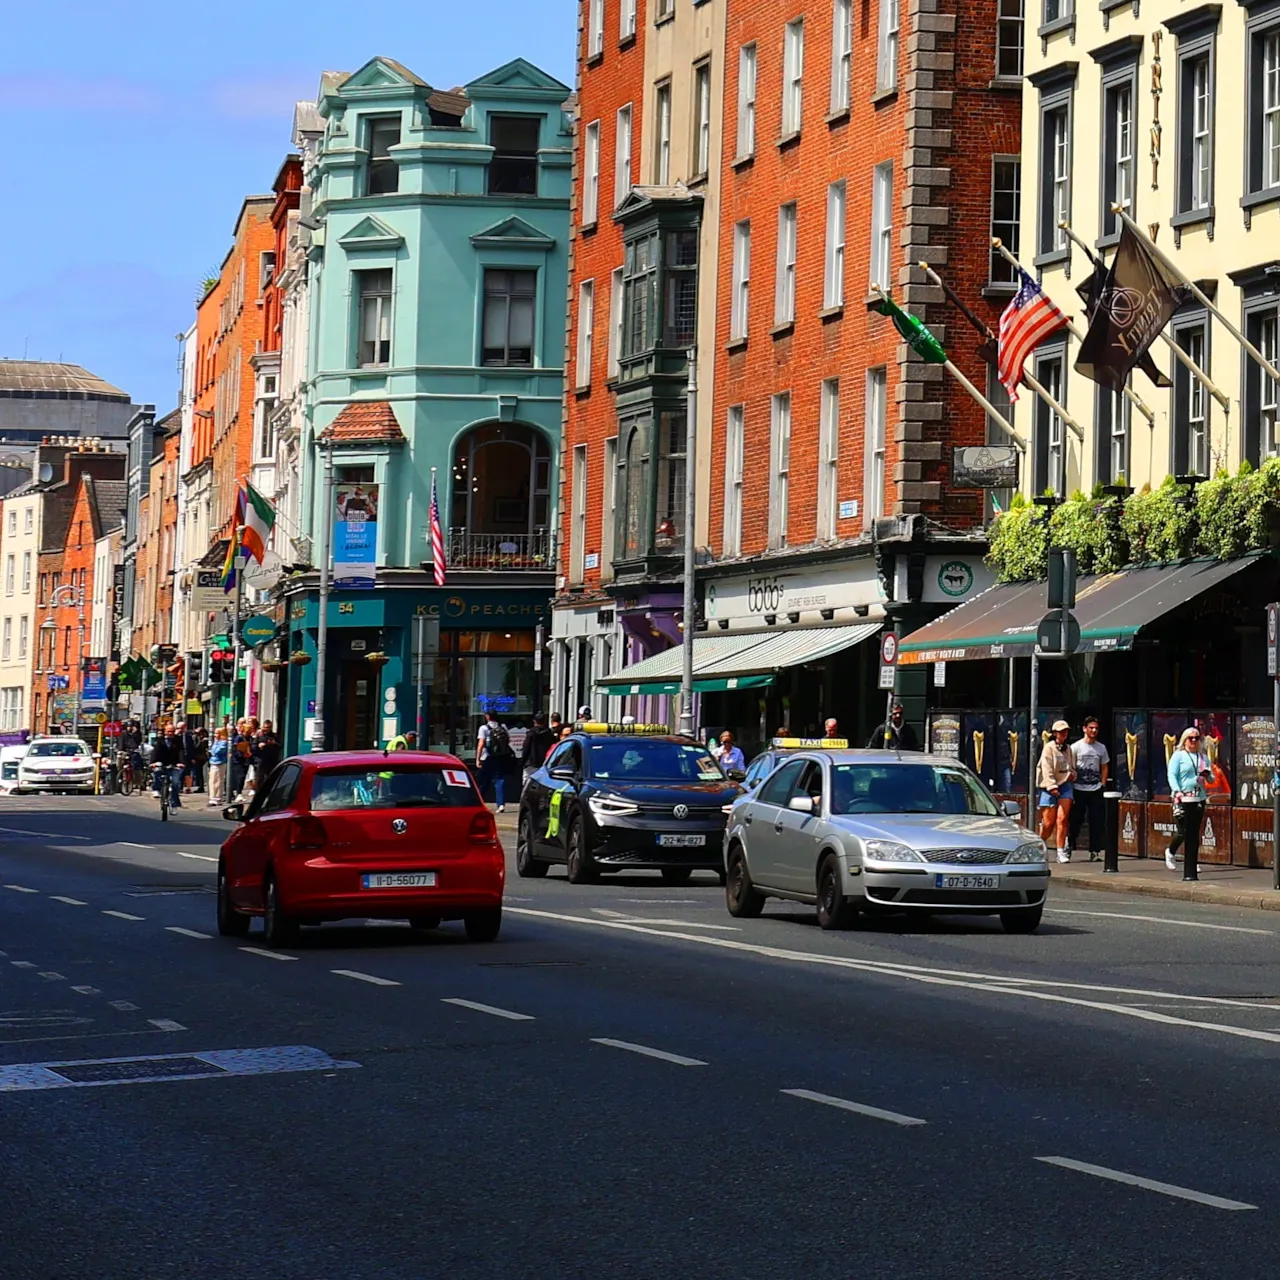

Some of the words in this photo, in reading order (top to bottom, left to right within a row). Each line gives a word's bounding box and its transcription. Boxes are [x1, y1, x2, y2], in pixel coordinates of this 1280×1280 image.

[339, 603, 354, 614] 54
[417, 605, 439, 615] KC
[610, 724, 633, 733] TAXI
[801, 739, 822, 747] TAXI
[1244, 754, 1258, 766] LIVE
[1258, 754, 1275, 767] SPOR
[375, 874, 427, 886] 11-D-56077
[948, 876, 993, 887] 07-D-7640
